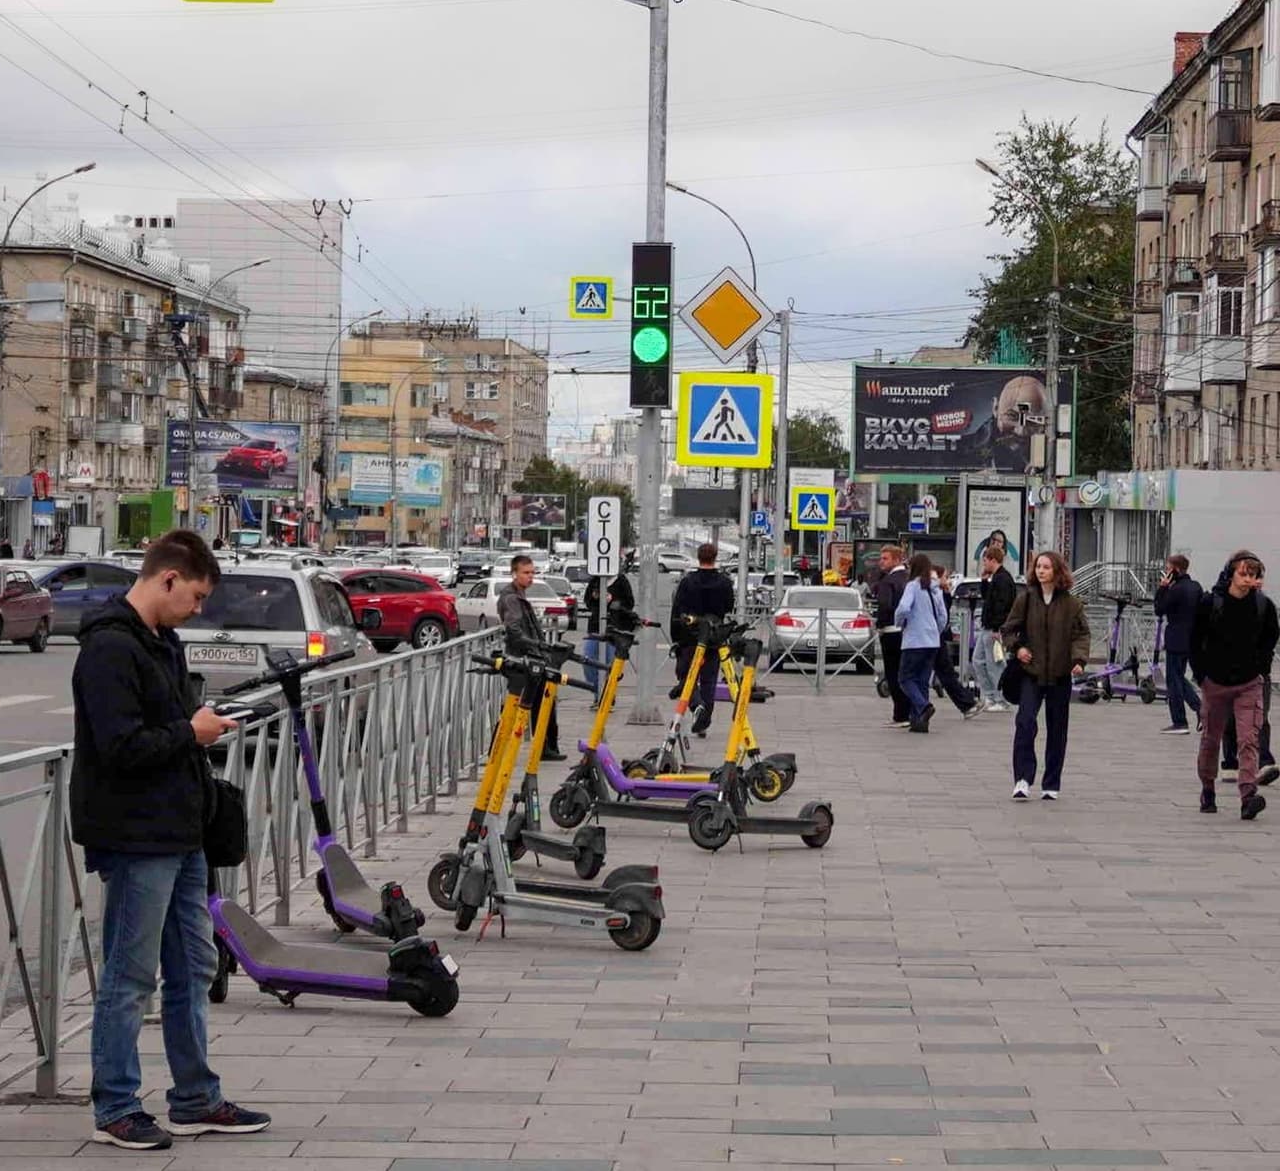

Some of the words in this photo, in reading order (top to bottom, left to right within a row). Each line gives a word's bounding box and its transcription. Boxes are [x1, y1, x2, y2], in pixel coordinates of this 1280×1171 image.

[633, 287, 669, 319] 62
[935, 411, 966, 421] НОВОЕ
[936, 419, 964, 428] МЕНЮ
[865, 417, 931, 434] ВКУС
[864, 434, 961, 450] КАЧАЕТ
[596, 500, 612, 573] СТОП
[238, 649, 255, 659] 154
